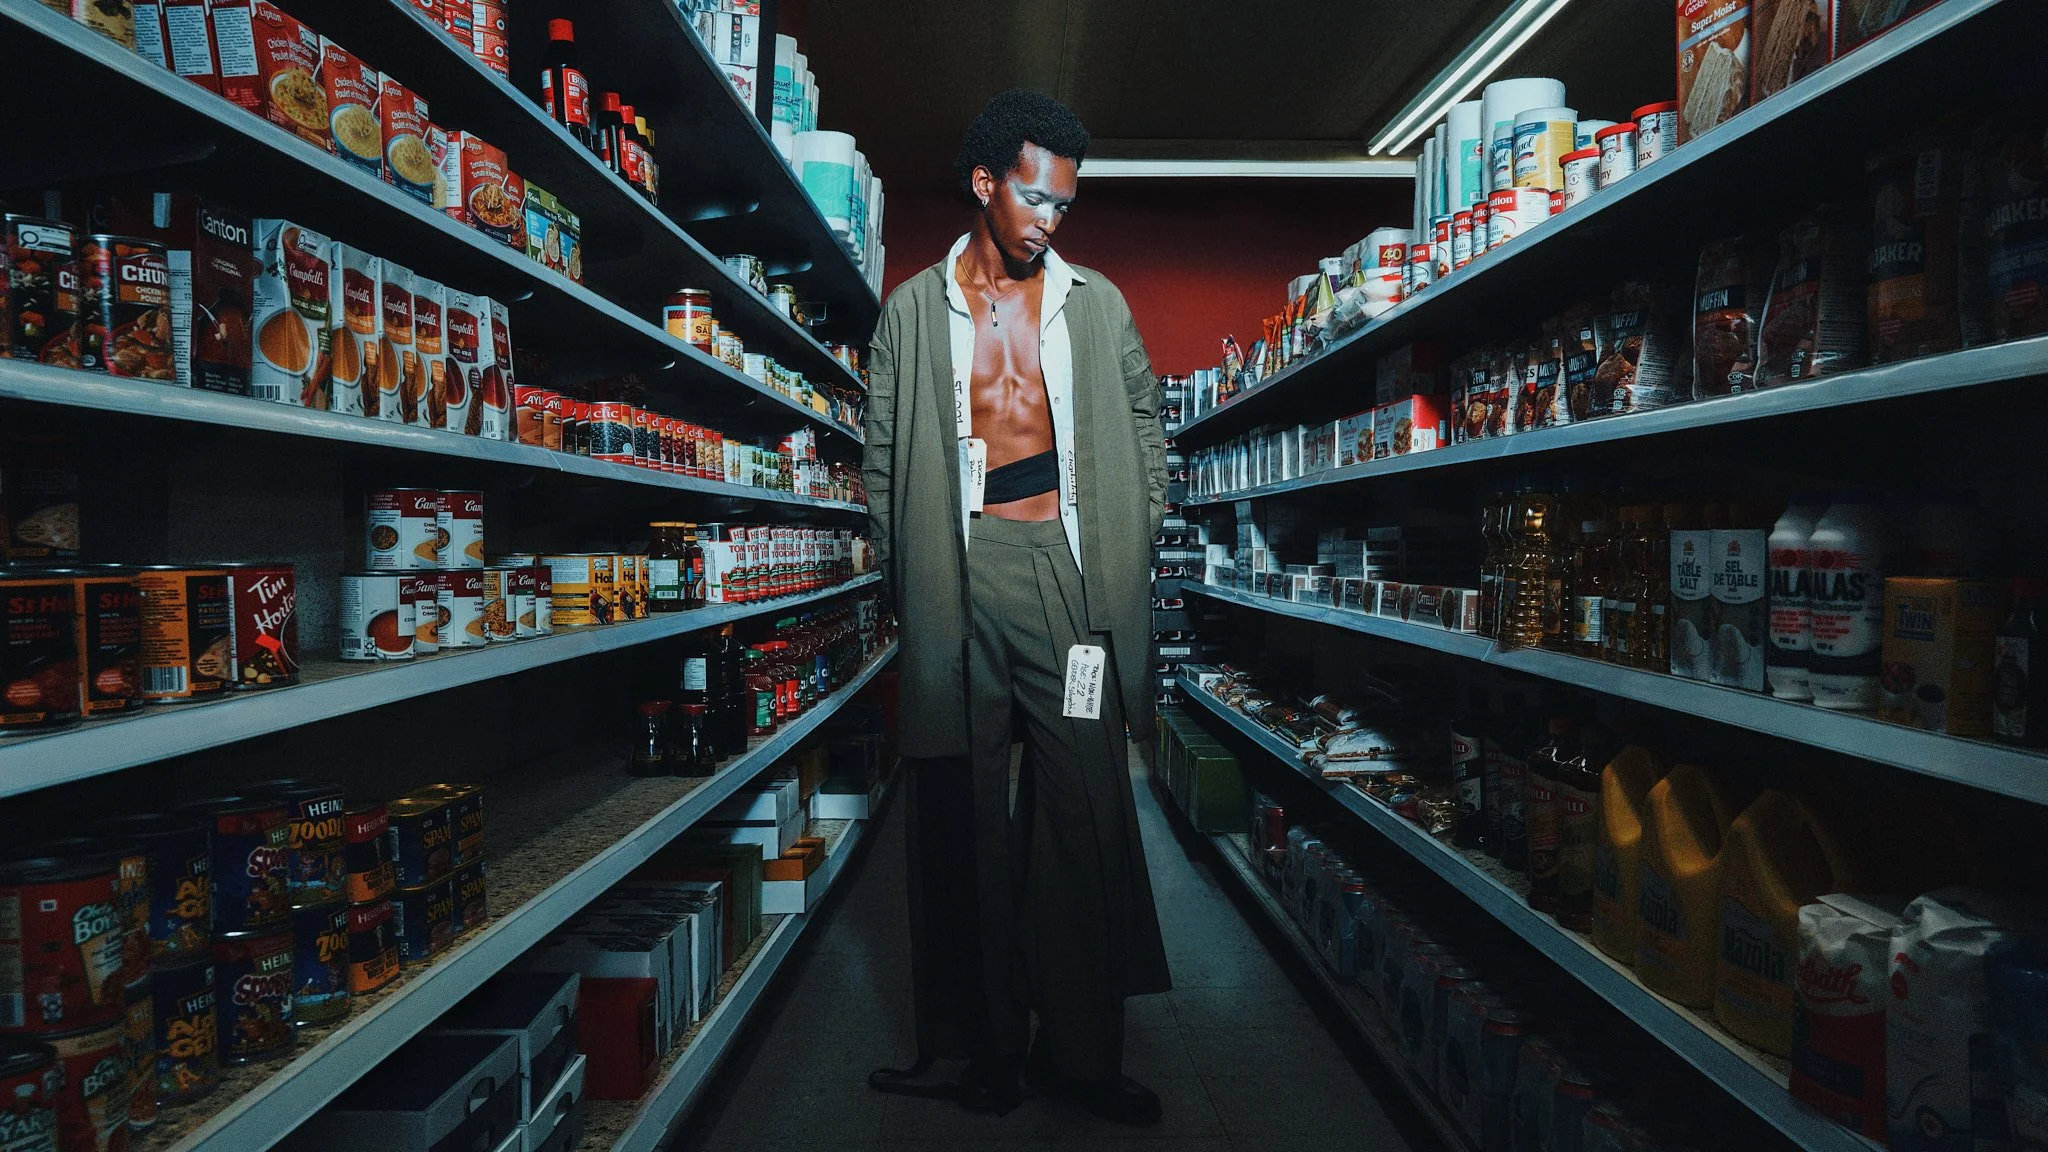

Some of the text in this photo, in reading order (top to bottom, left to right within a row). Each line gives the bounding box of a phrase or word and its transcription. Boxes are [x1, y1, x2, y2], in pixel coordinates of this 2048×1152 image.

[260, 6, 282, 22] Lipton
[1691, 1, 1737, 33] Super Moist
[327, 49, 347, 63] Lipton
[335, 77, 353, 88] Chicken
[385, 84, 402, 96] Lipton
[201, 209, 247, 245] Canton
[289, 262, 325, 286] Campbell's
[345, 281, 370, 303] Campbell's
[383, 295, 408, 315] Campbell's
[449, 318, 475, 335] Campbell's
[593, 405, 619, 419] clic
[1677, 564, 1701, 577] TABLE
[1725, 561, 1742, 573] SEL
[1679, 577, 1699, 590] SALT
[1713, 573, 1758, 588] DE TABLE
[247, 575, 287, 605] Tim
[1076, 680, 1086, 697] 22
[423, 824, 451, 849] SPAM
[461, 877, 485, 900] SPAM
